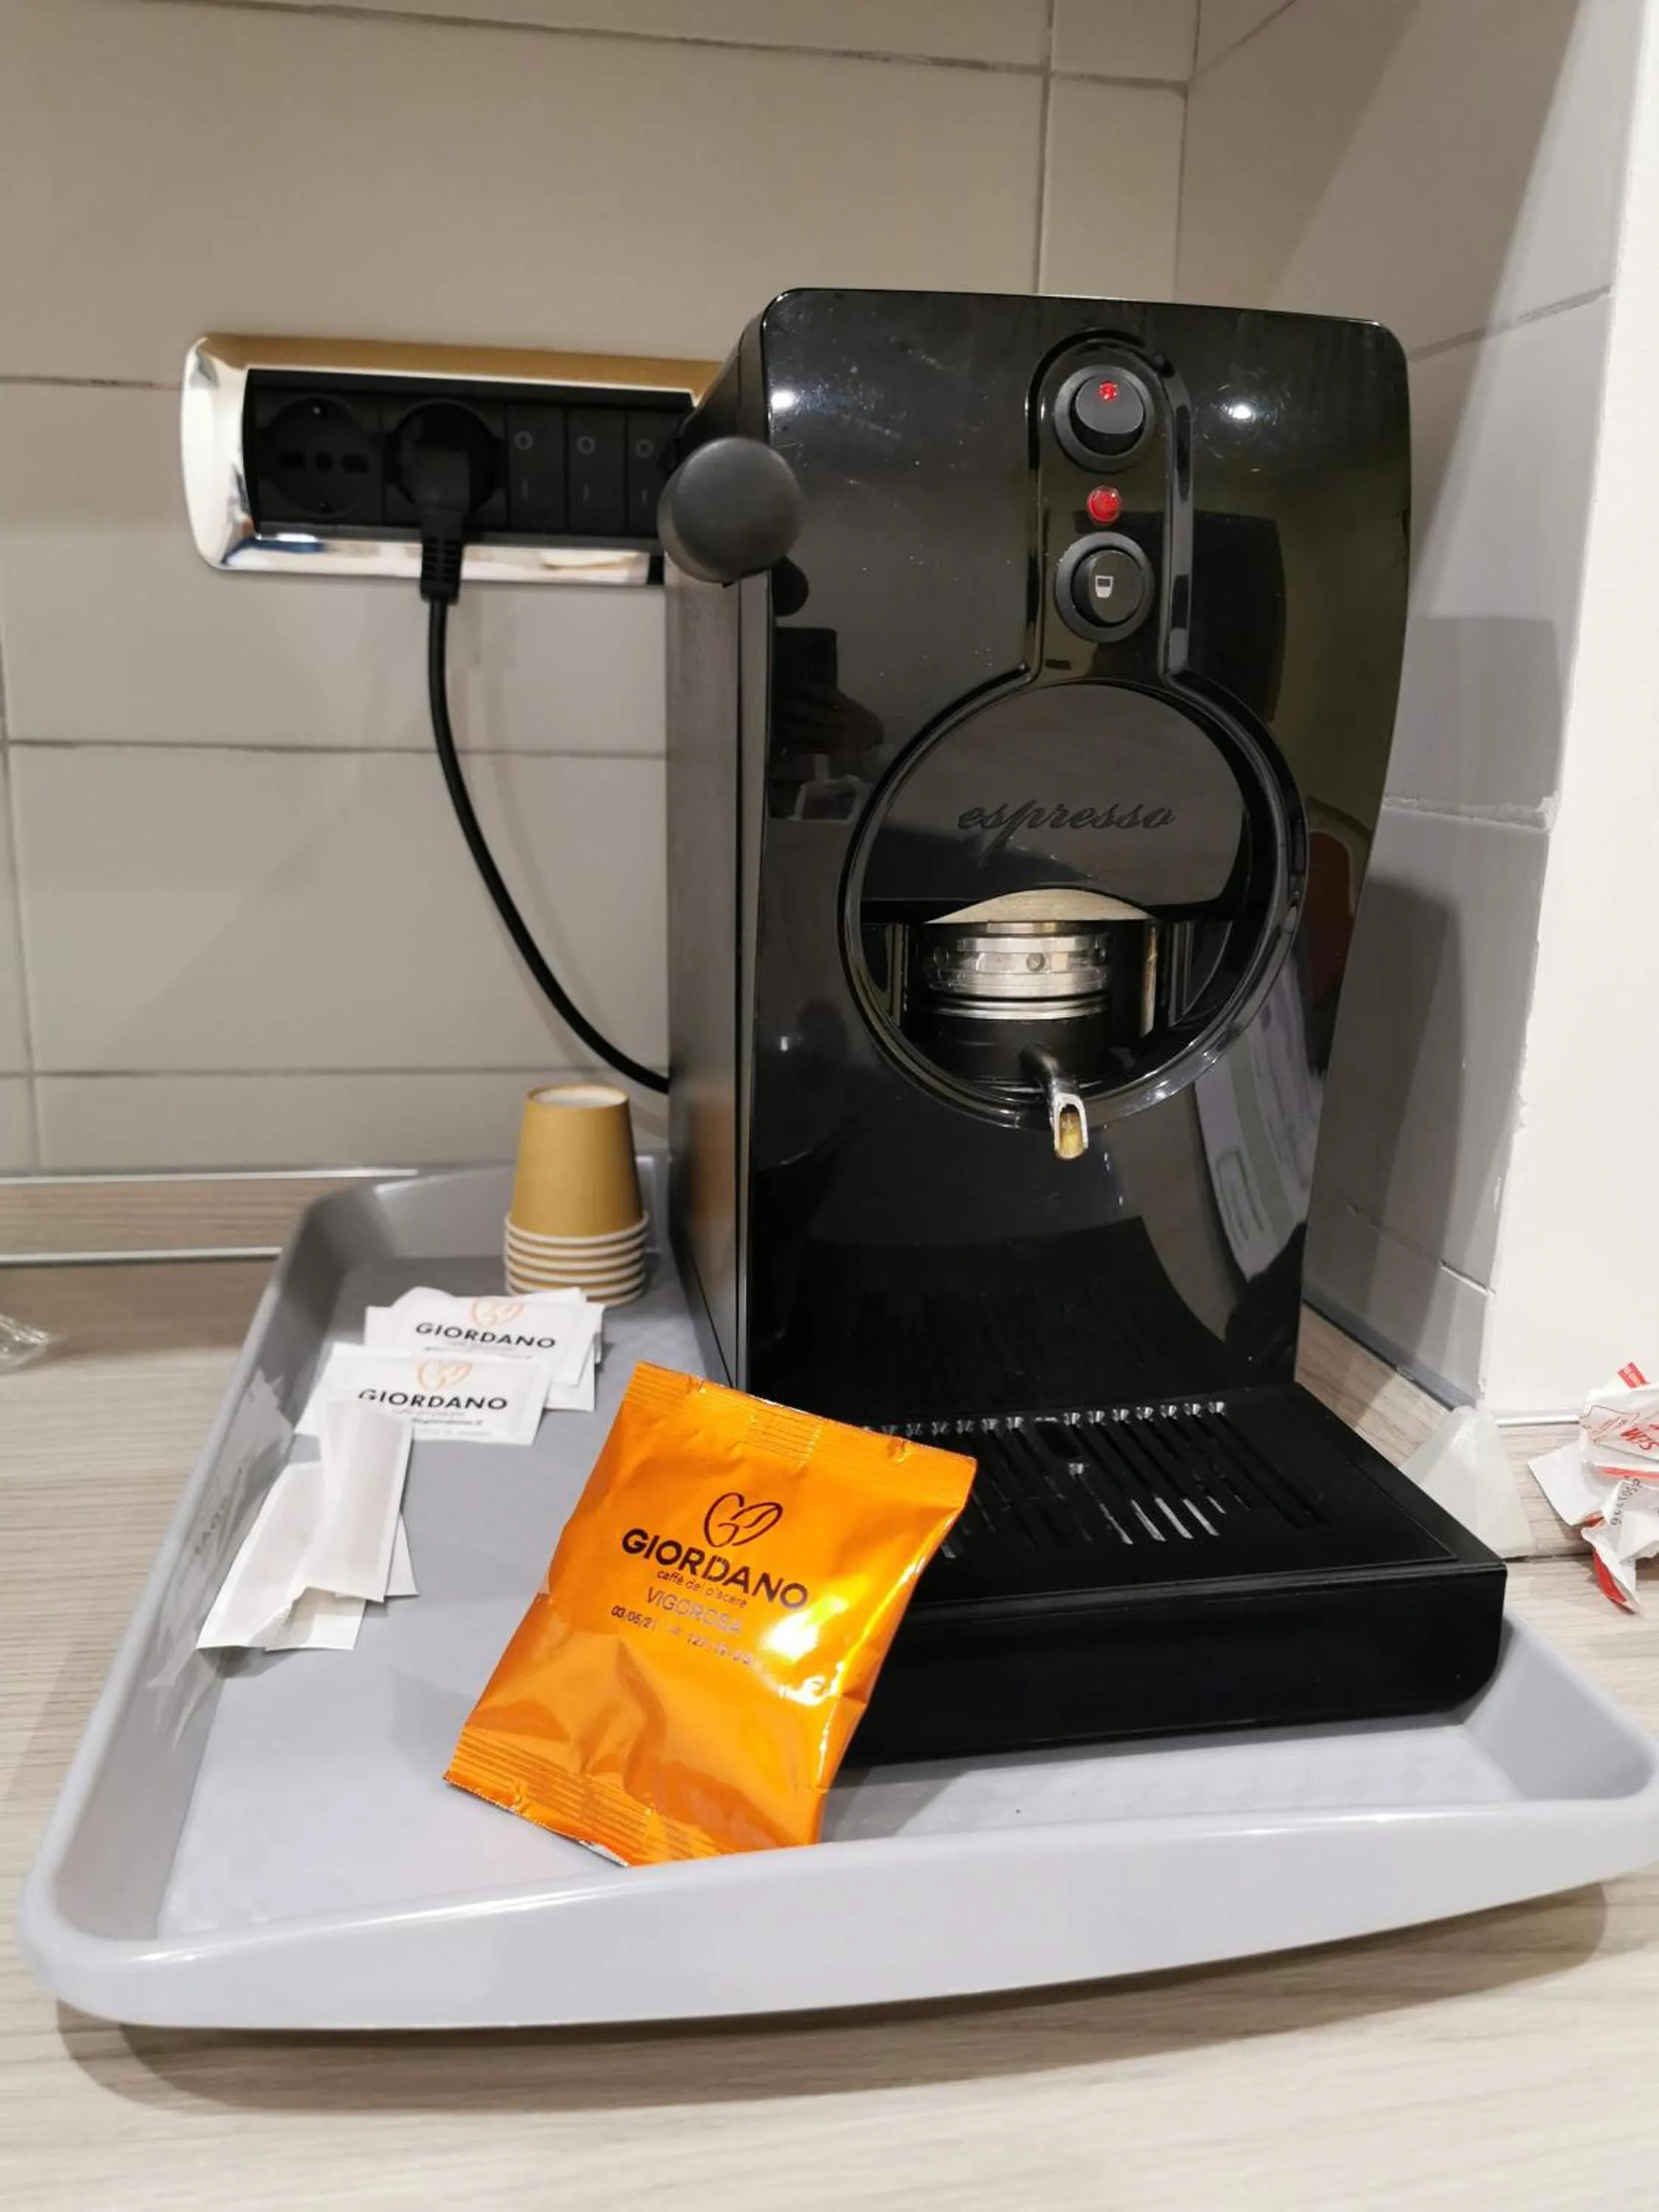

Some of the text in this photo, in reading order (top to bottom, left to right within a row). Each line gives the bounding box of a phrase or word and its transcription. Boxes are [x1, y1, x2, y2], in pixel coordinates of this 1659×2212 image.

[957, 799, 1178, 855] espresso
[415, 1321, 557, 1349] GIORDANO
[358, 1388, 509, 1411] GIORDANO
[621, 1528, 809, 1610] GIORDANO
